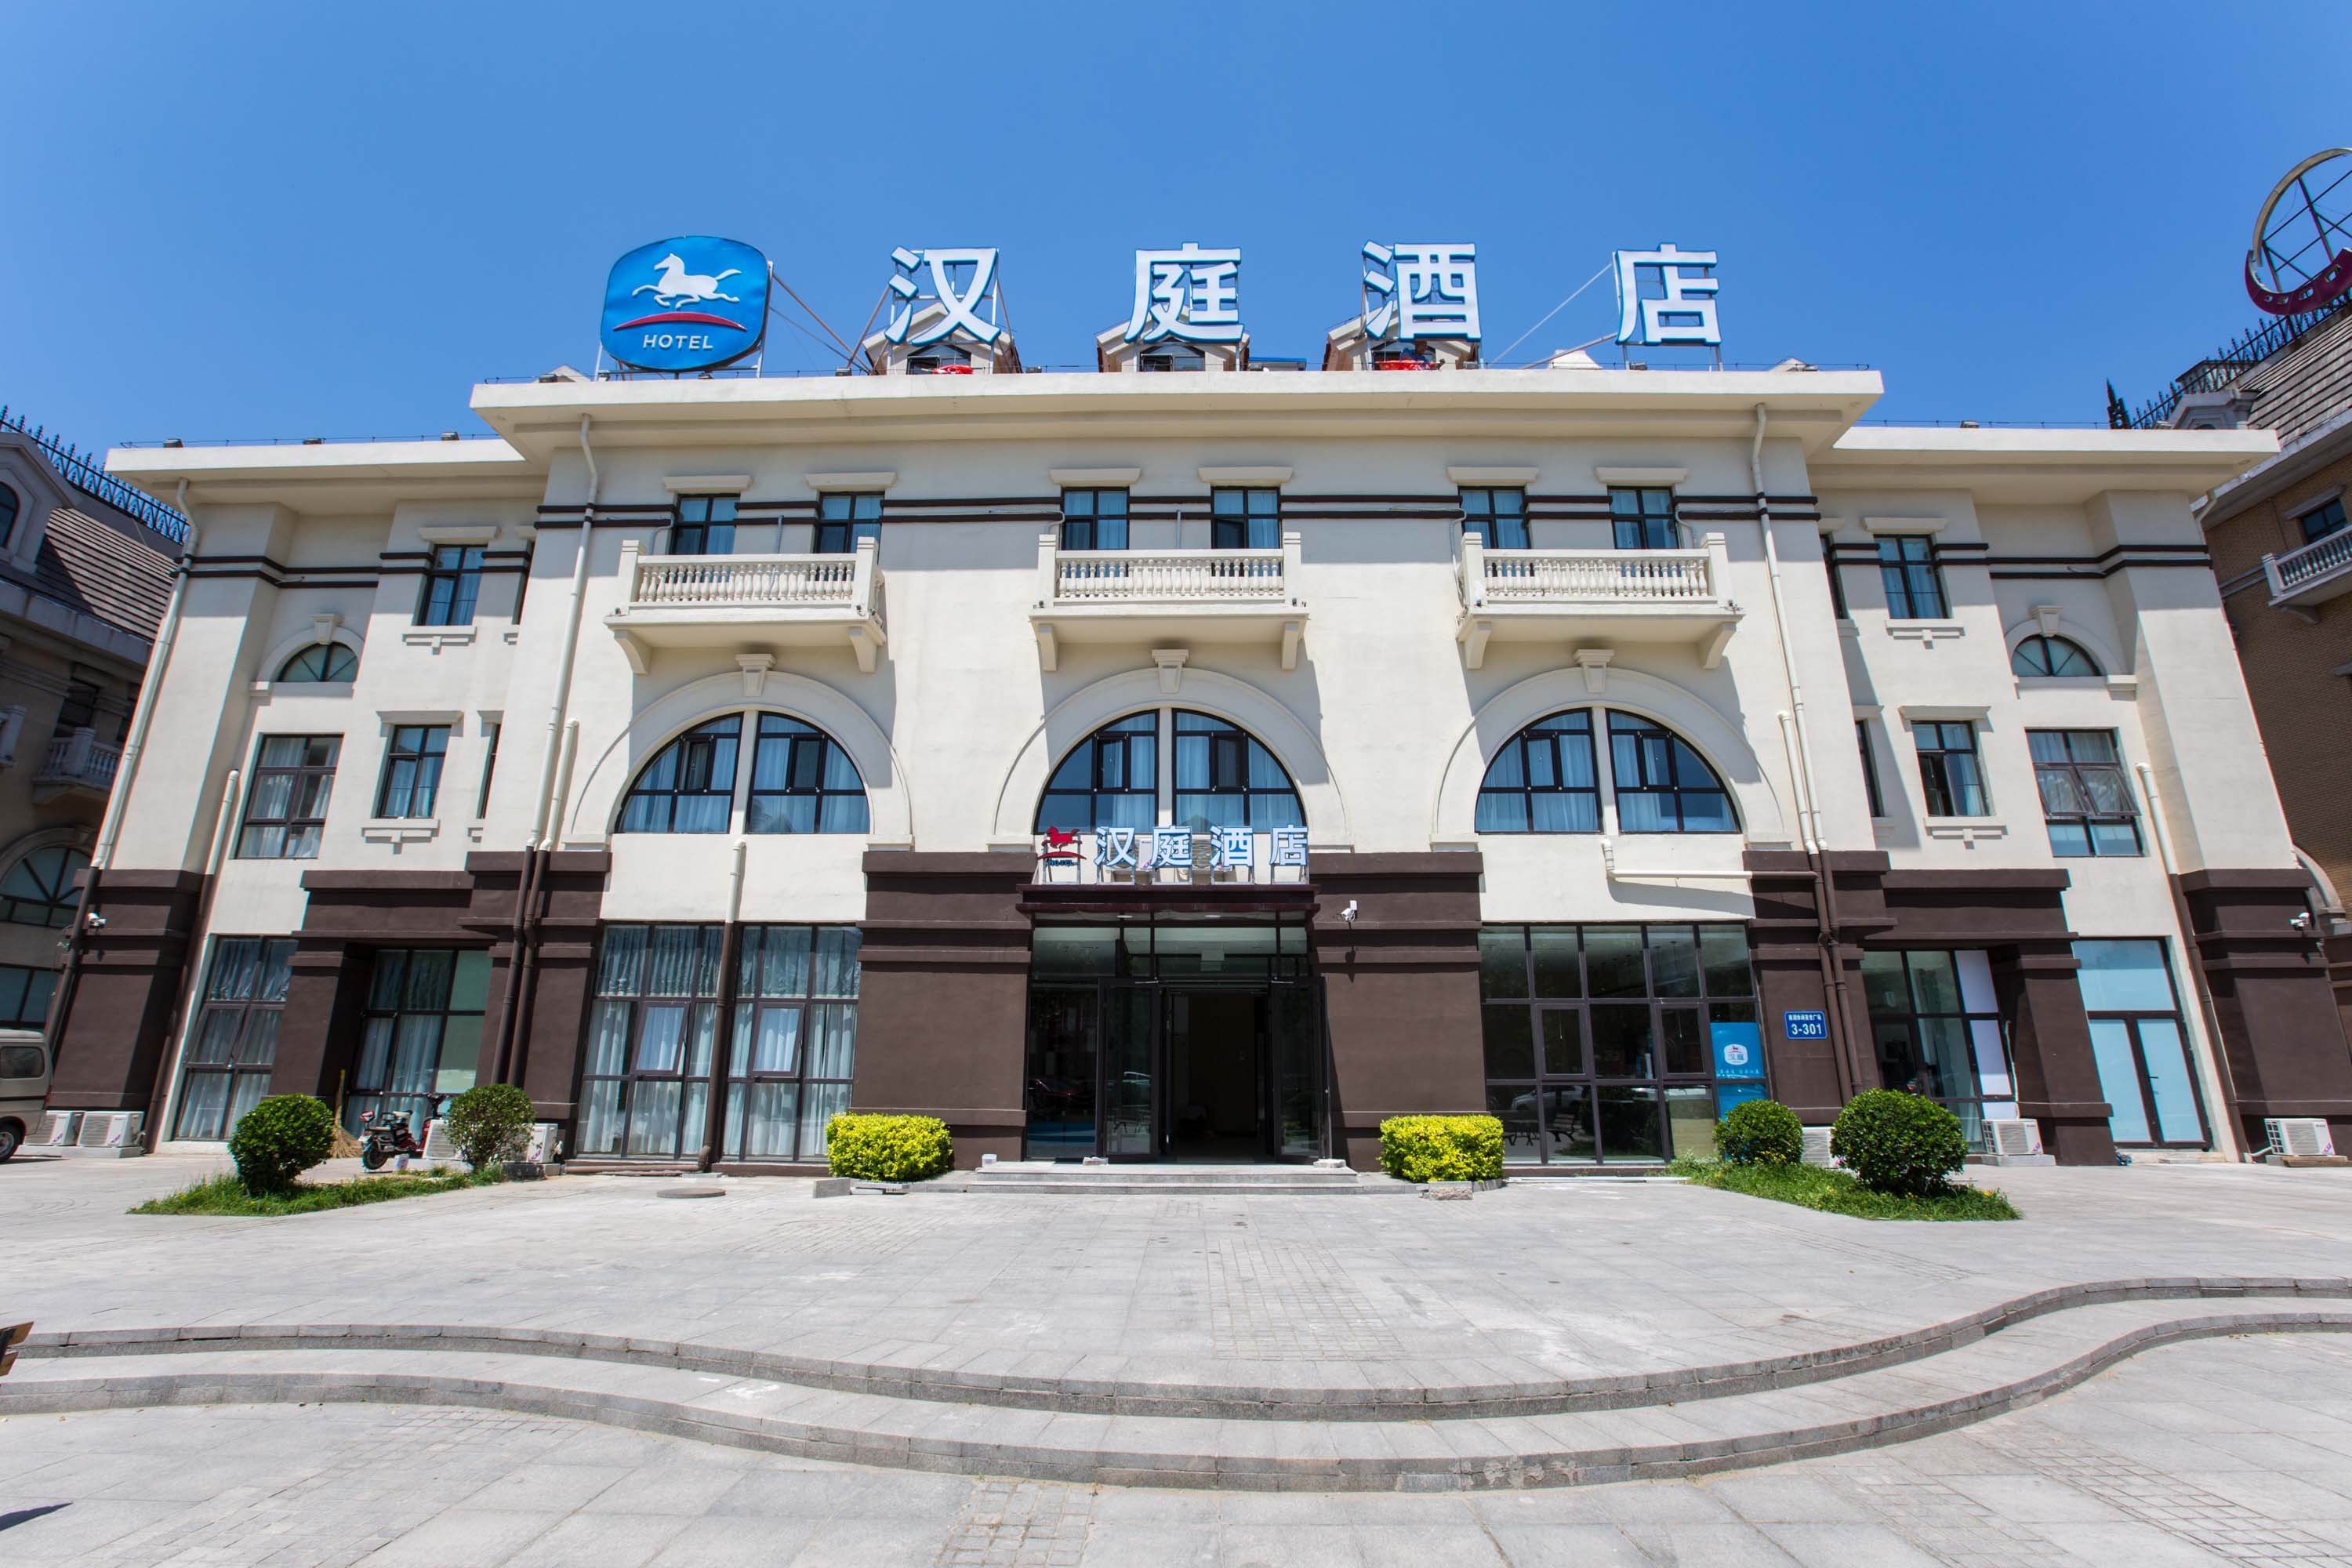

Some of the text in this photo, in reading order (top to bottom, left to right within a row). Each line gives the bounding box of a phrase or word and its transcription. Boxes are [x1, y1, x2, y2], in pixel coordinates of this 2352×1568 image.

[884, 241, 1722, 347] 汉庭酒店
[642, 334, 713, 351] HOTEL
[1094, 825, 1308, 867] 汉庭酒店
[1791, 1023, 1822, 1035] 3-301
